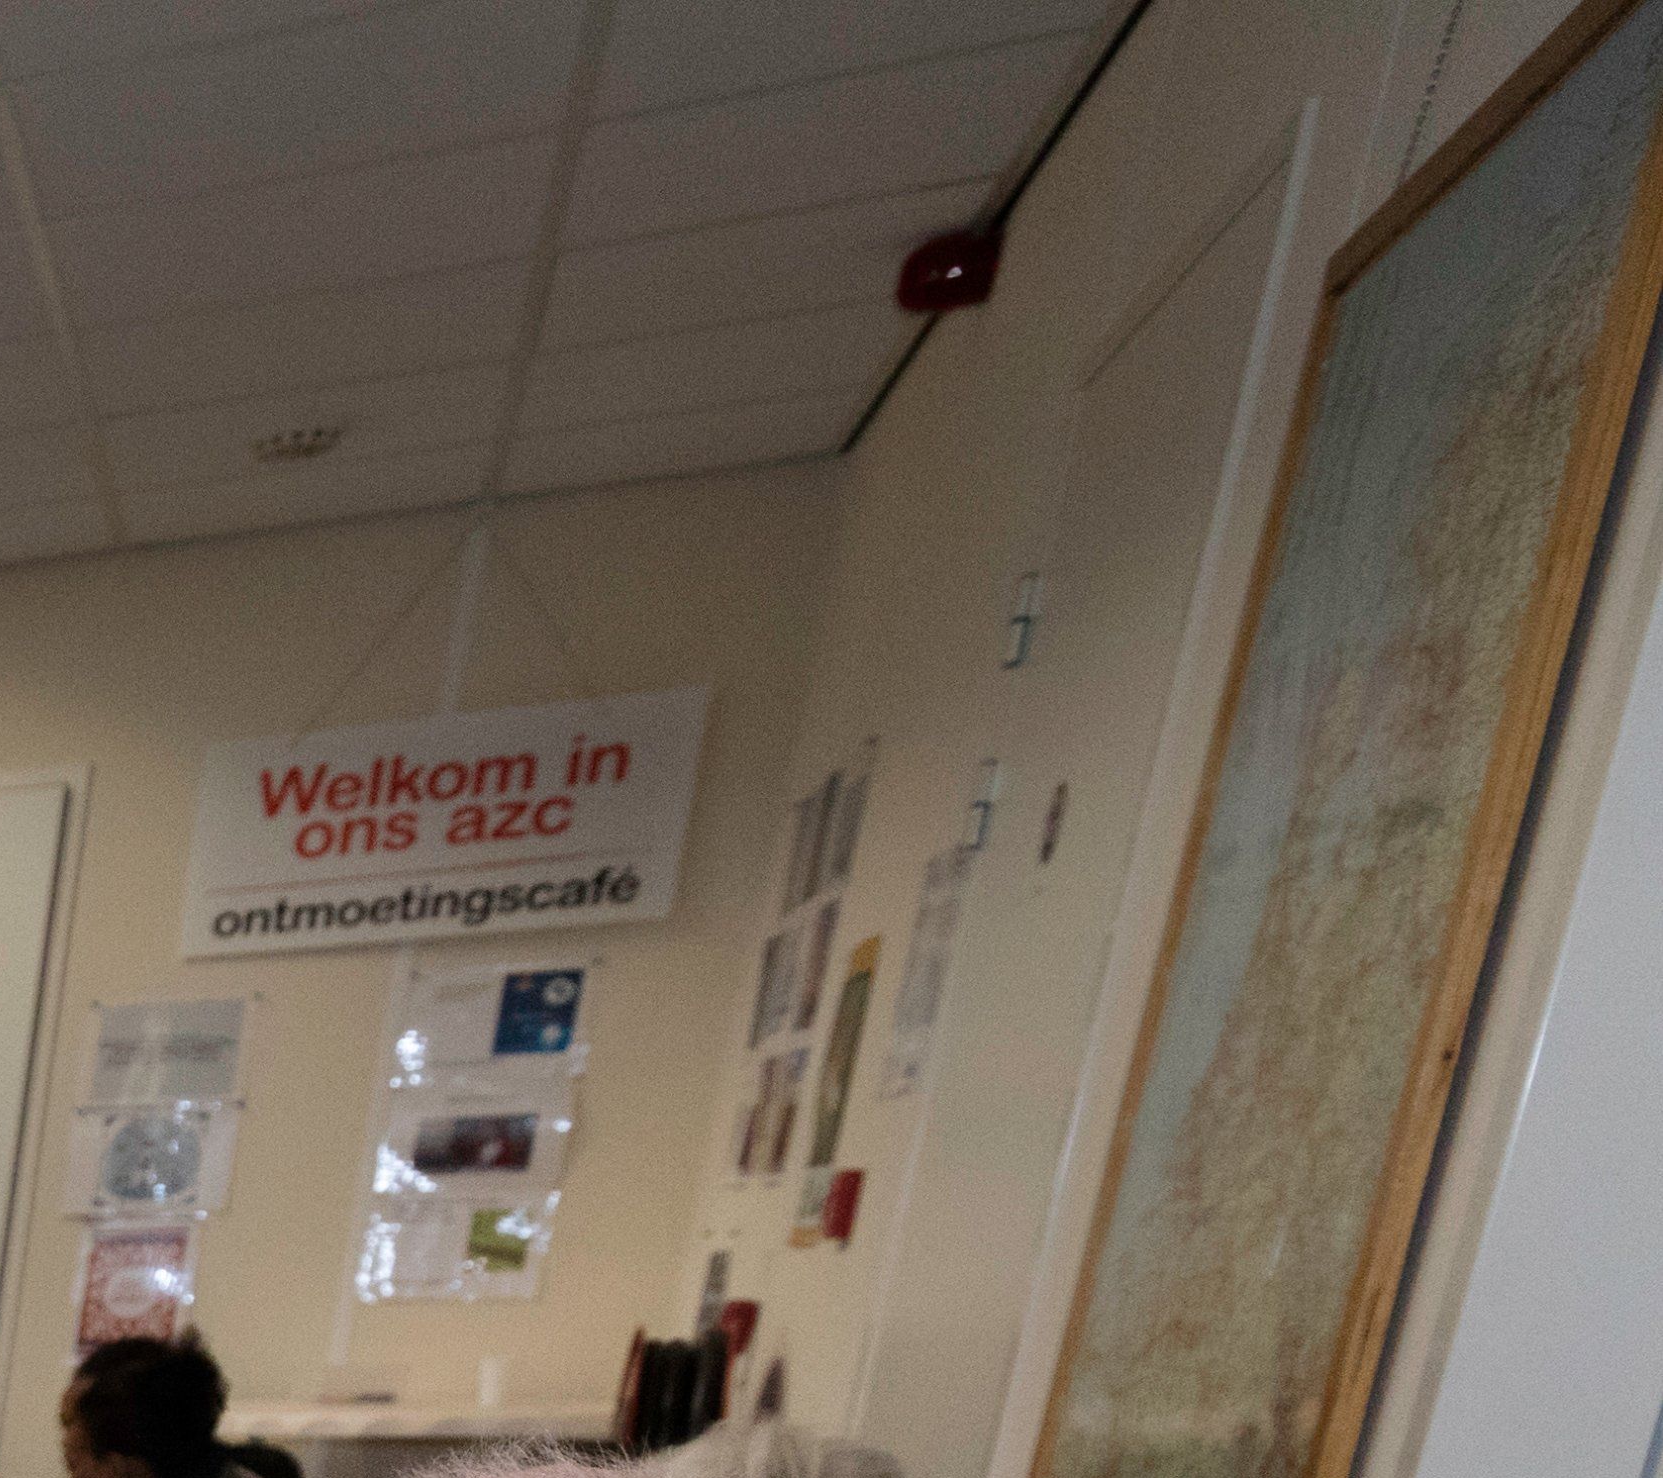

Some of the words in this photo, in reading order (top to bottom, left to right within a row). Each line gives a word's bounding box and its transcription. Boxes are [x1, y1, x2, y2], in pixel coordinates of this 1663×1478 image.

[259, 752, 539, 819] Welkom
[565, 733, 631, 788] in
[294, 809, 419, 860] ons
[445, 794, 575, 848] azc
[212, 864, 642, 939] ontmoetingscafé
